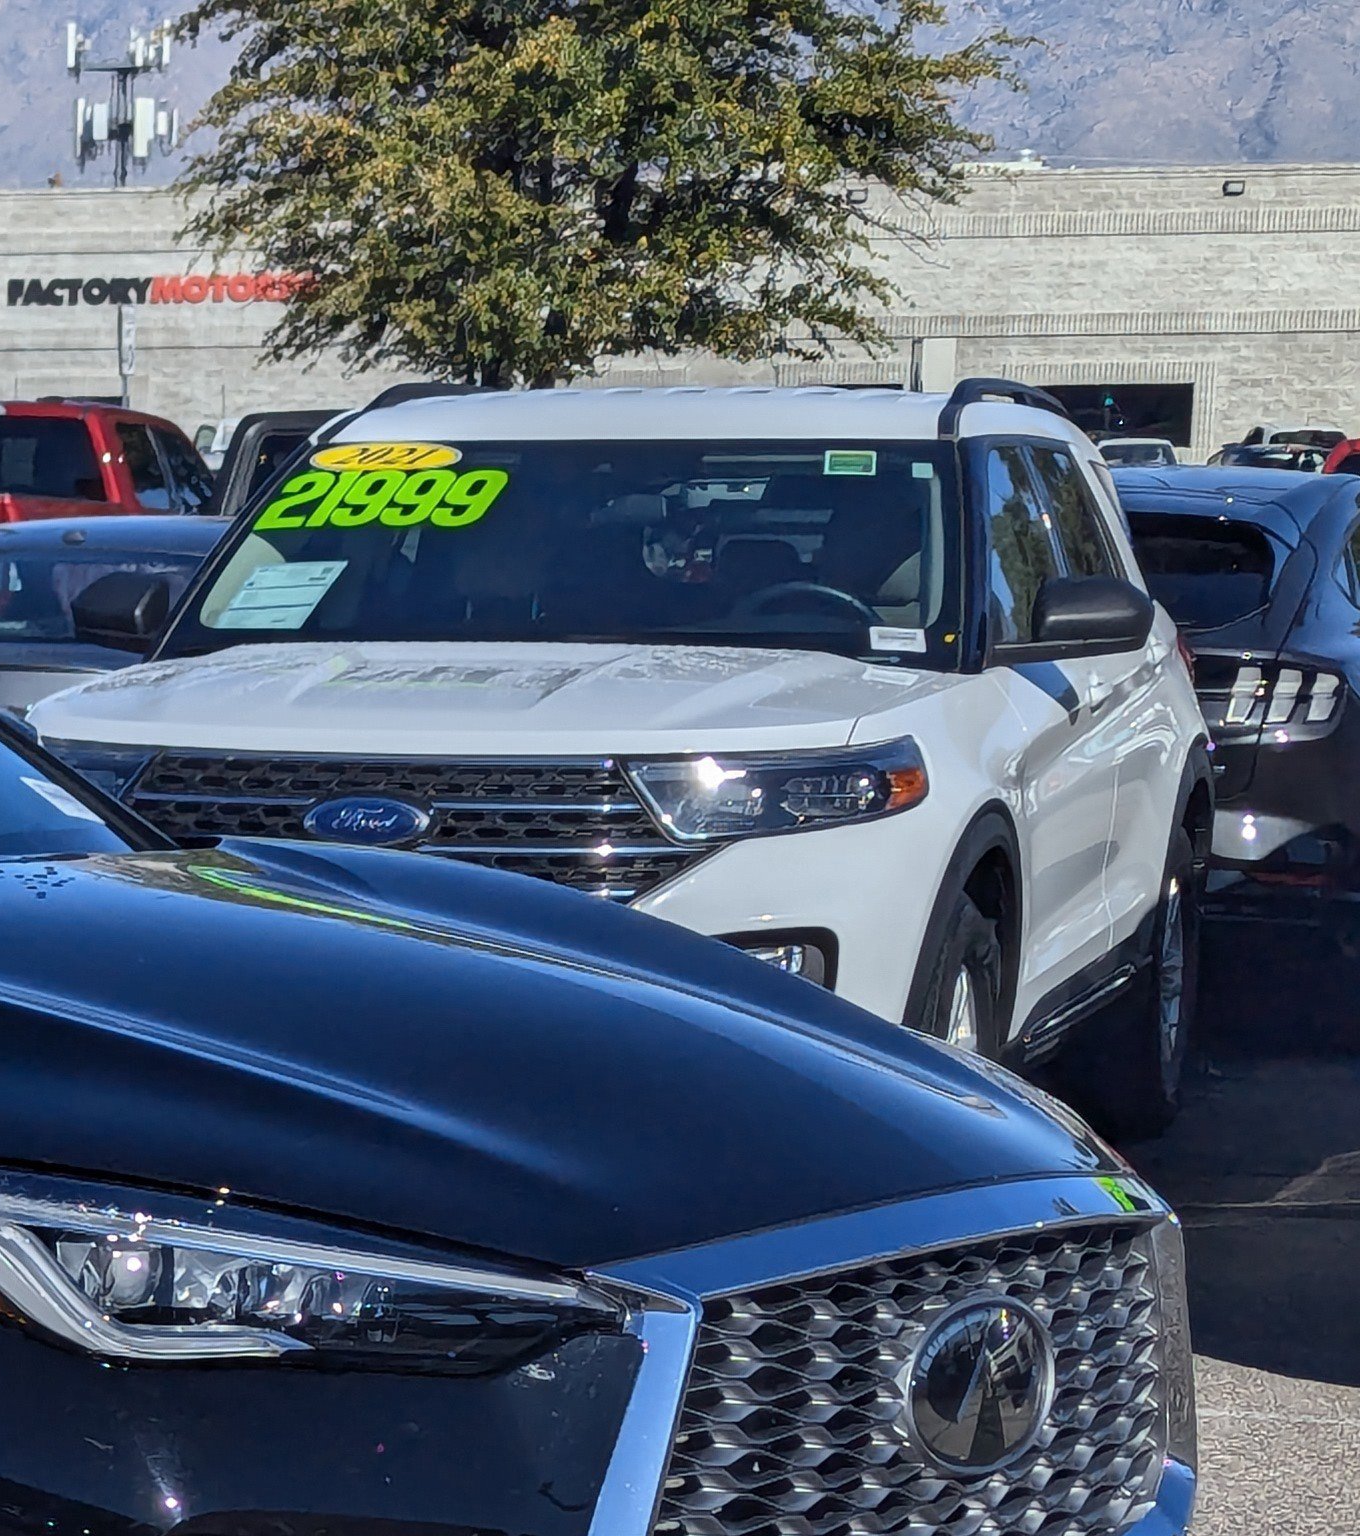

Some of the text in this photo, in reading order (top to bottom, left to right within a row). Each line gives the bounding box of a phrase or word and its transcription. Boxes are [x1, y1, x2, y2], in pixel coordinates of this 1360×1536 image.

[329, 447, 441, 466] 2021
[252, 467, 510, 532] 21999
[331, 807, 399, 832] Ford
